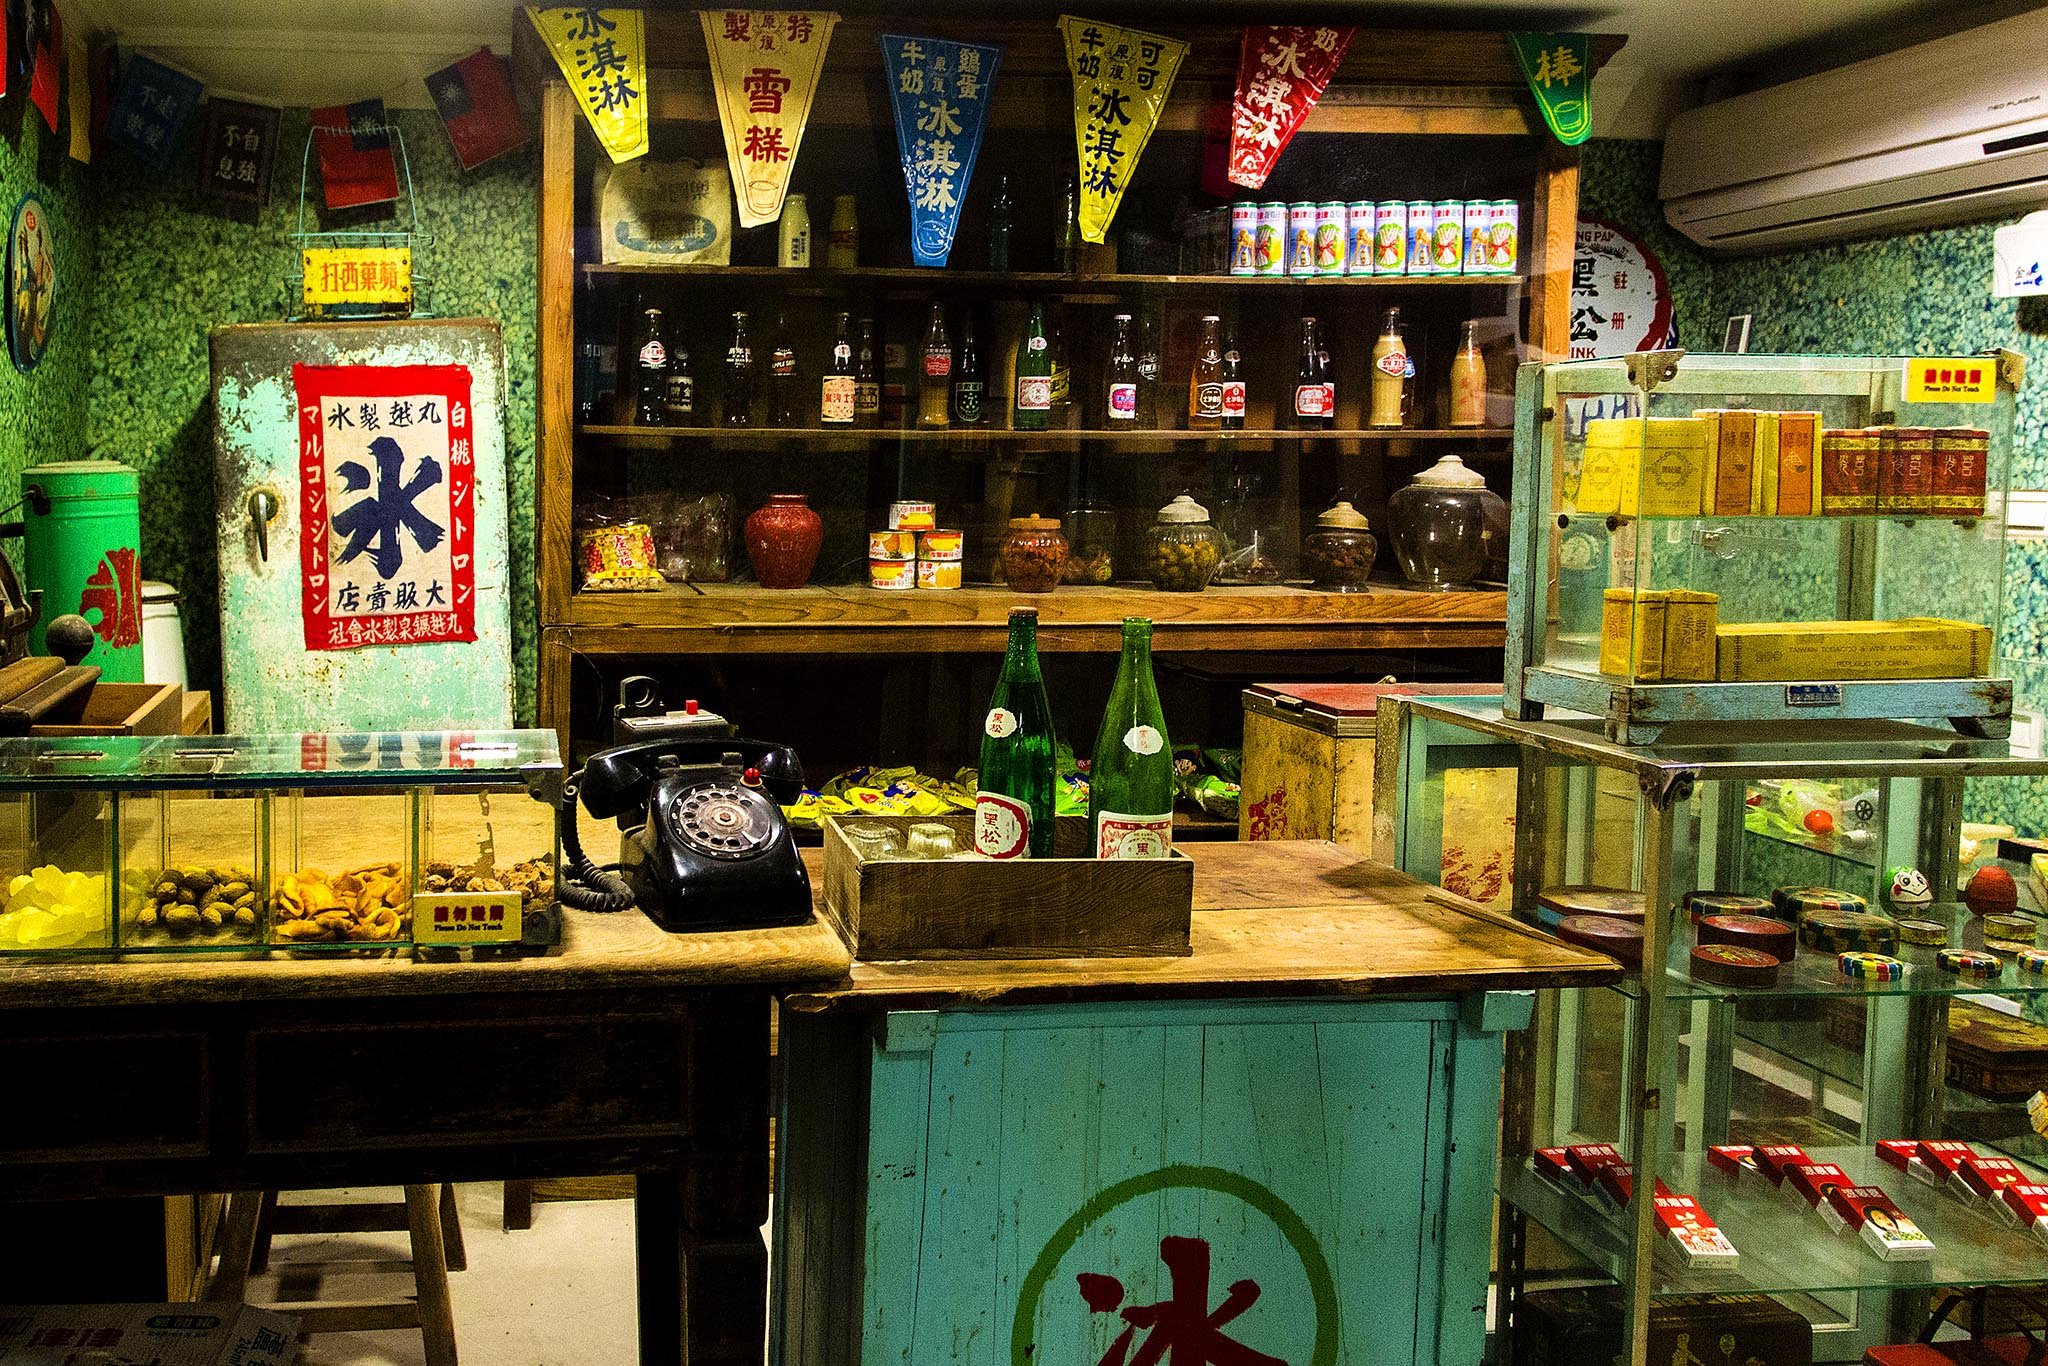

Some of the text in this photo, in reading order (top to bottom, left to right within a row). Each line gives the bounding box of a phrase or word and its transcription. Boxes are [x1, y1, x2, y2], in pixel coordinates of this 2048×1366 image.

[900, 41, 925, 94] 牛奶
[1077, 27, 1105, 79] 牛奶
[1137, 41, 1165, 90] 可可
[1534, 46, 1582, 88] 棒
[743, 68, 791, 163] 雪糕
[916, 100, 963, 214] 冰淇淋
[1083, 87, 1131, 199] 冰淇淋
[1887, 659, 1910, 667] CHINA
[1932, 643, 1963, 651] BUREAU
[980, 812, 1002, 845] 黑松
[482, 923, 503, 931] Touch
